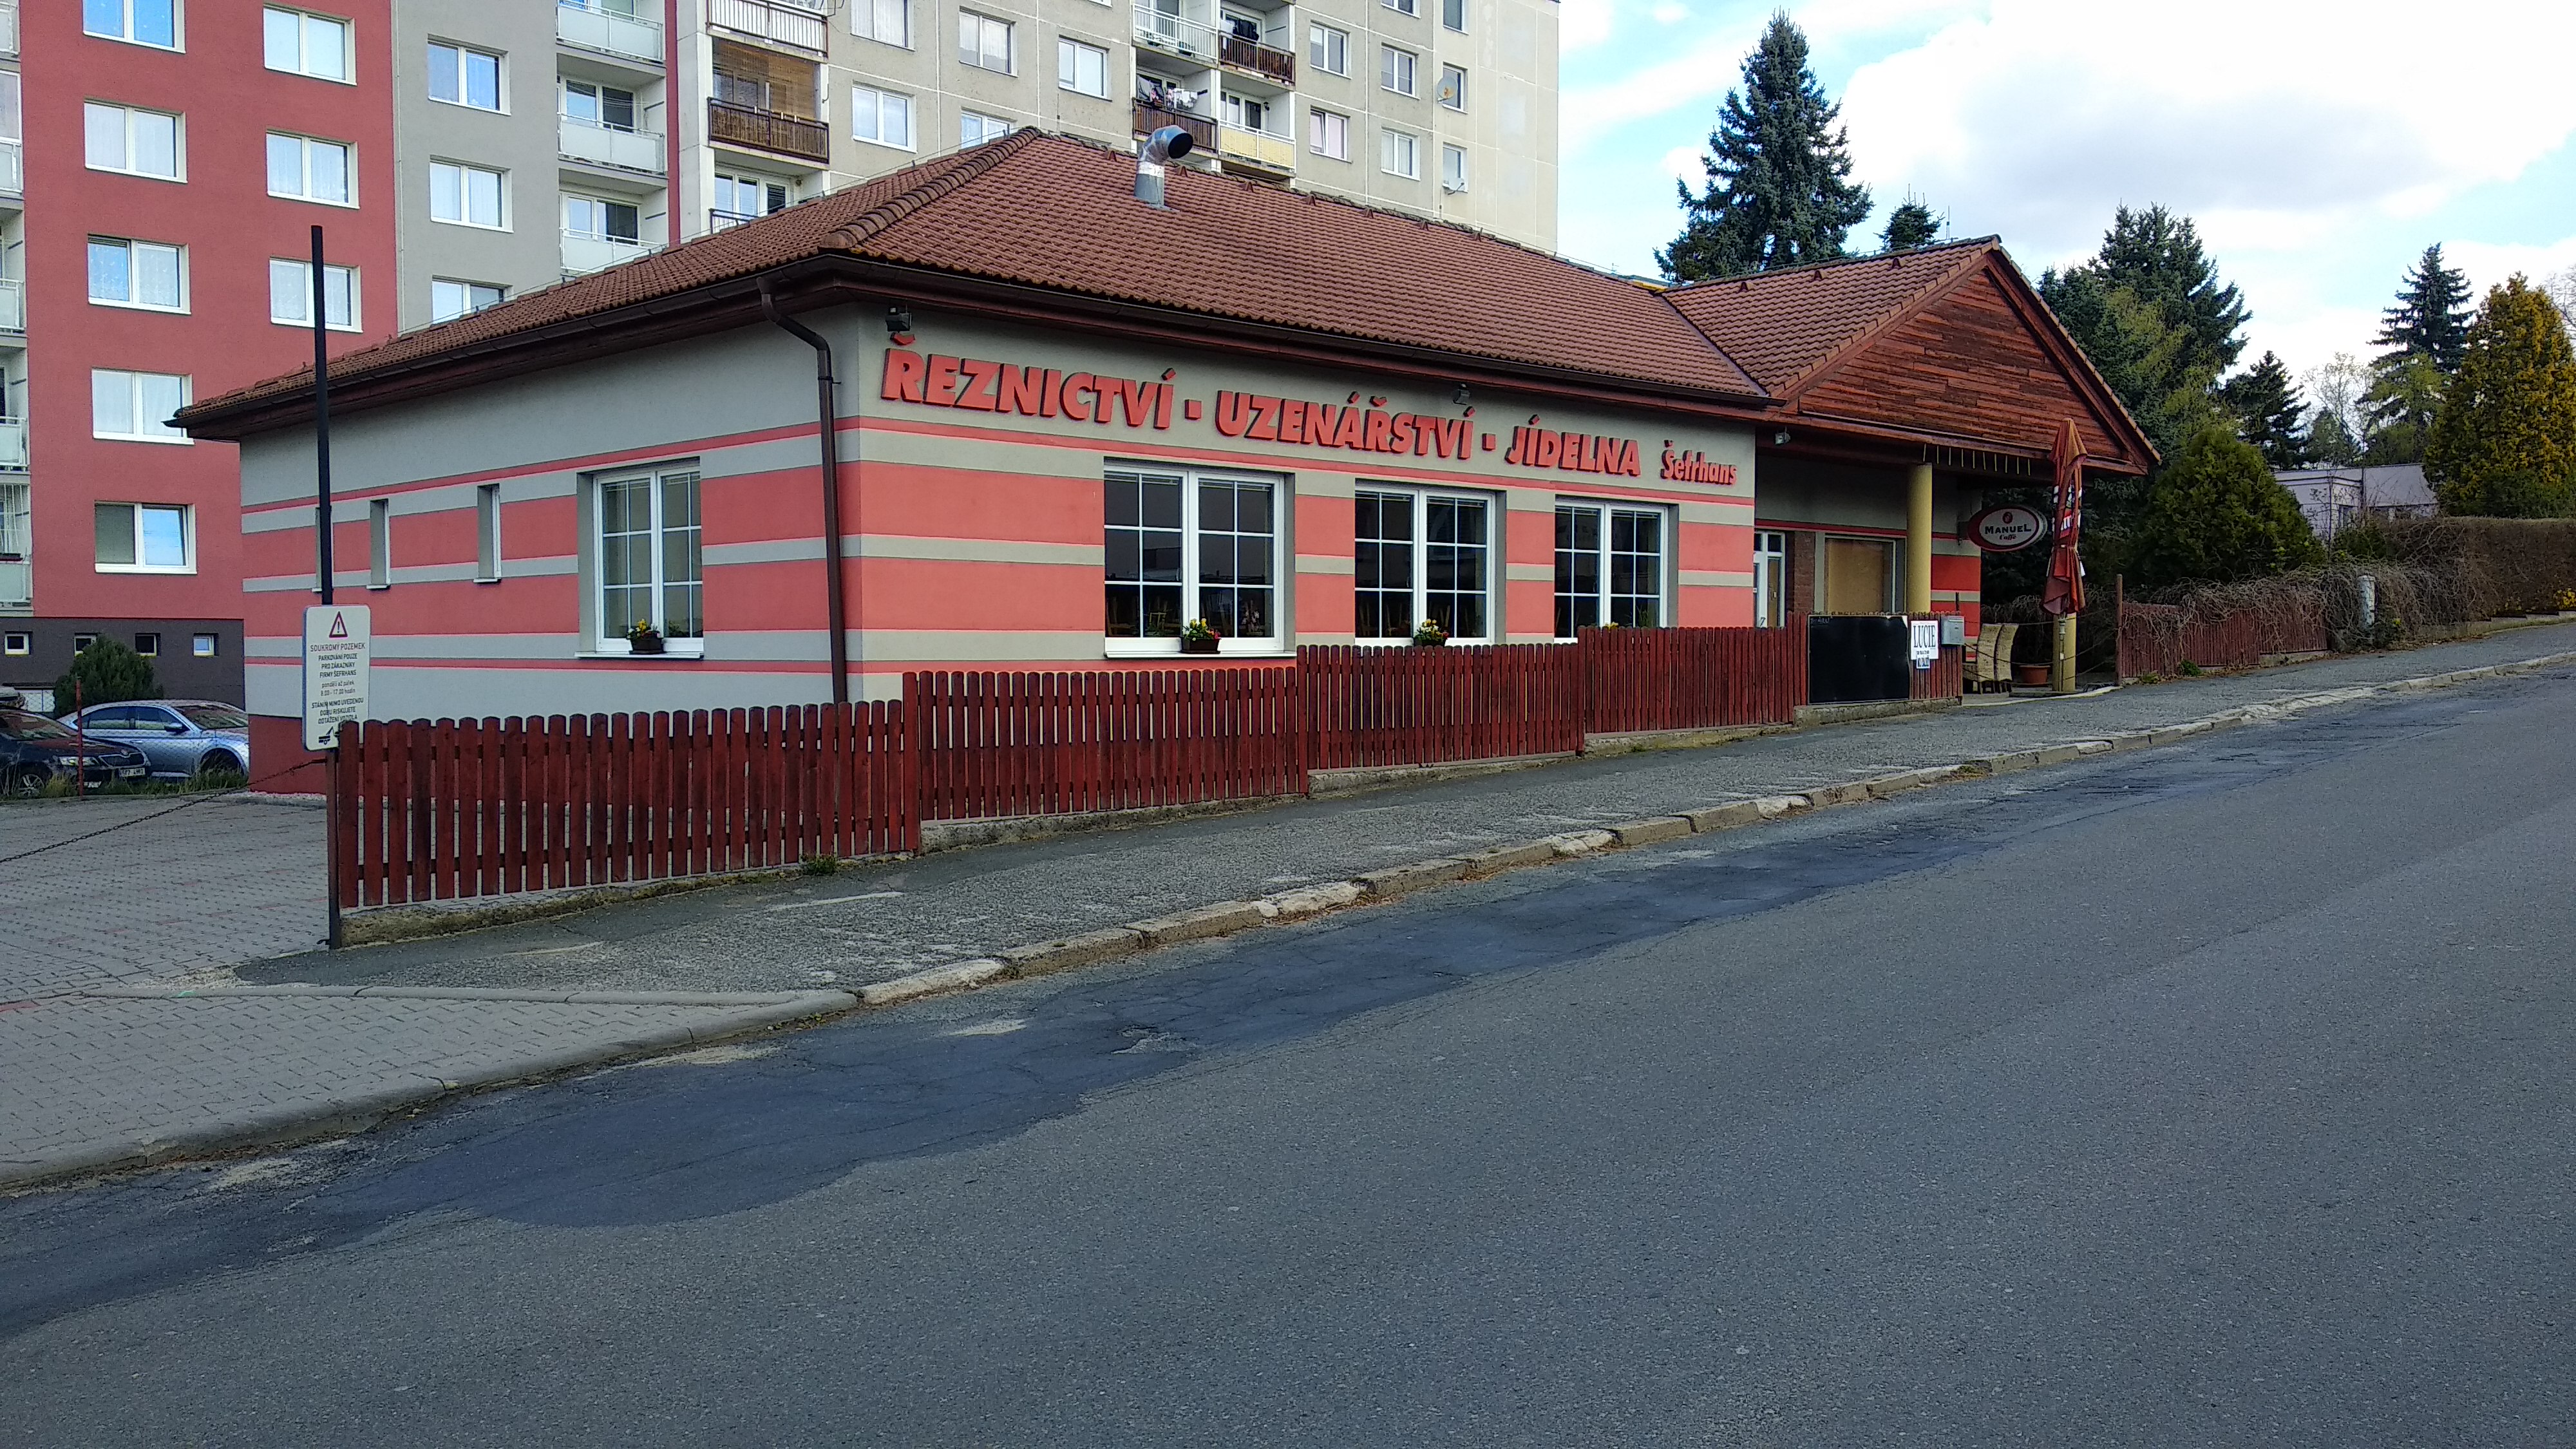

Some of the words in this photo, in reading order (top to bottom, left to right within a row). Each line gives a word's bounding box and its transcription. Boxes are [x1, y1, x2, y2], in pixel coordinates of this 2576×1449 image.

[881, 332, 1176, 429] ŘEZNICTVÍ
[1215, 391, 1475, 460] UZENÁŘSTVÍ
[1505, 414, 1642, 476] JÍDELNA
[1661, 439, 1738, 486] Šefrhans
[1913, 625, 1936, 648] LUCIE
[310, 643, 339, 652] SOUKROMÝ
[318, 653, 343, 661] PARKOVÁNÍ
